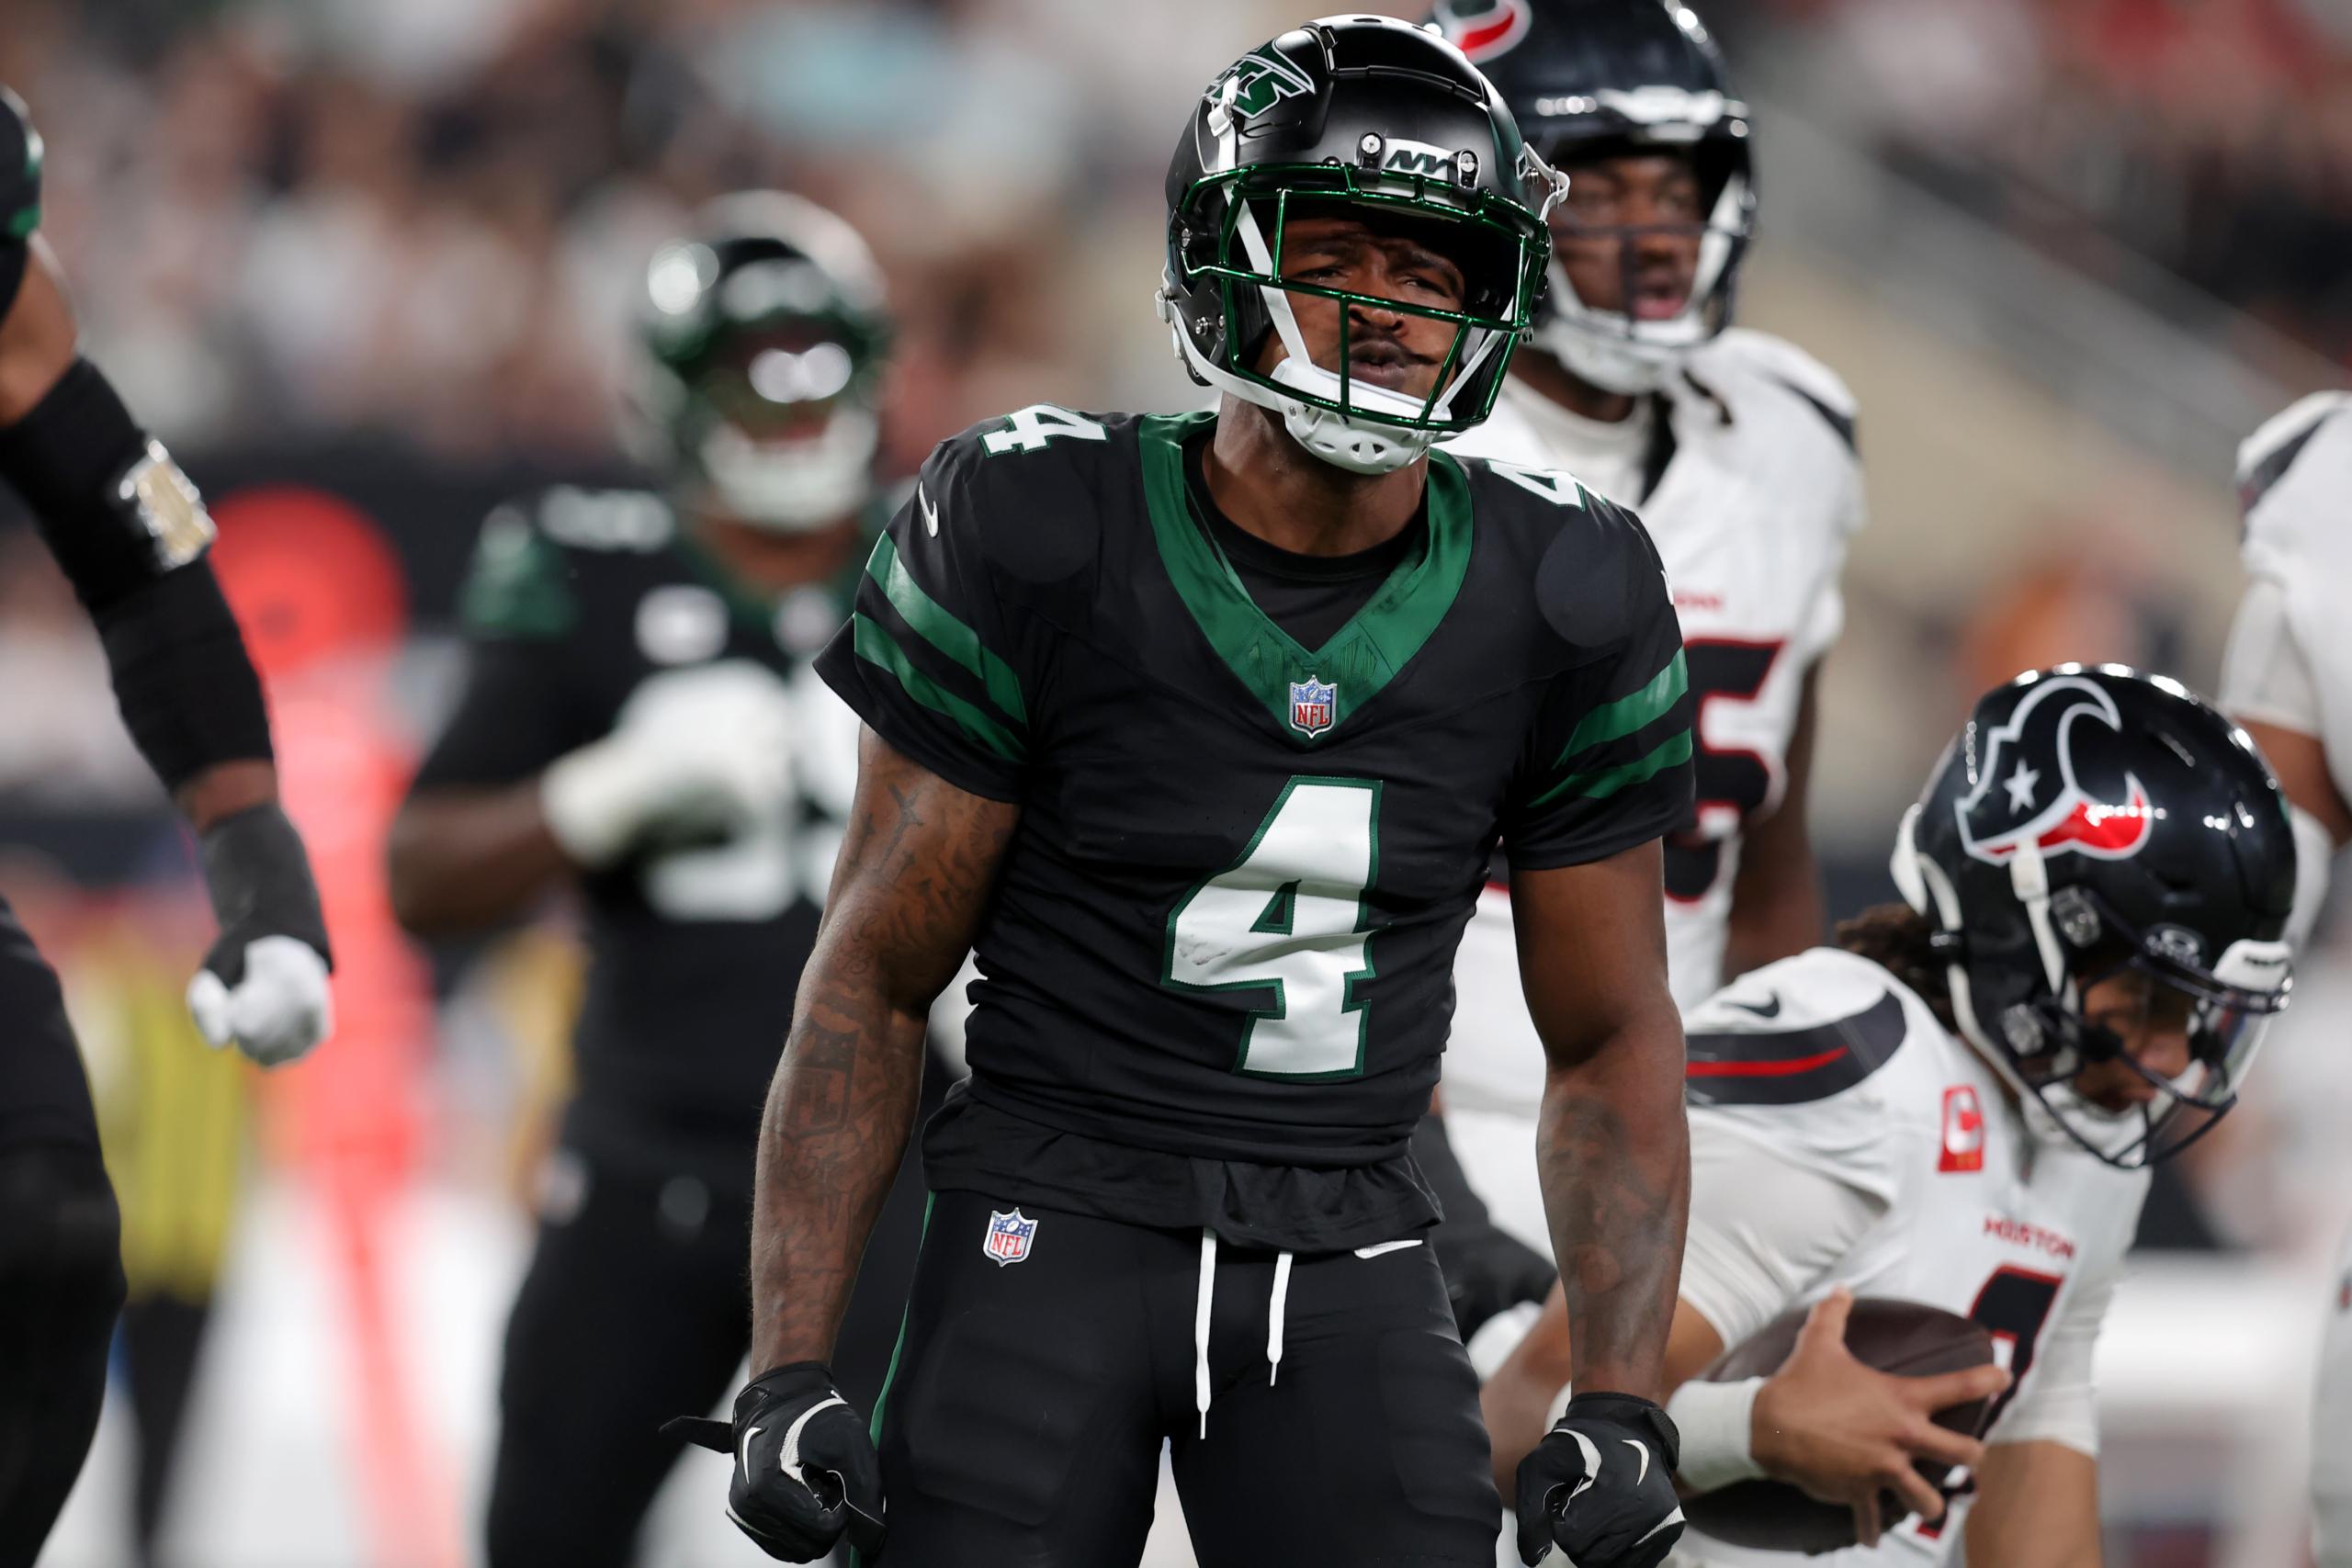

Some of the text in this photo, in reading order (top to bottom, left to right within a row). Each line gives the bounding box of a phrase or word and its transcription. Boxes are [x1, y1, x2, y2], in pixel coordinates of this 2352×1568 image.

[978, 402, 1111, 458] 4
[1485, 458, 1607, 513] 4
[1296, 705, 1329, 728] NFL
[1160, 775, 1383, 1080] 4
[991, 1232, 1023, 1257] NFL
